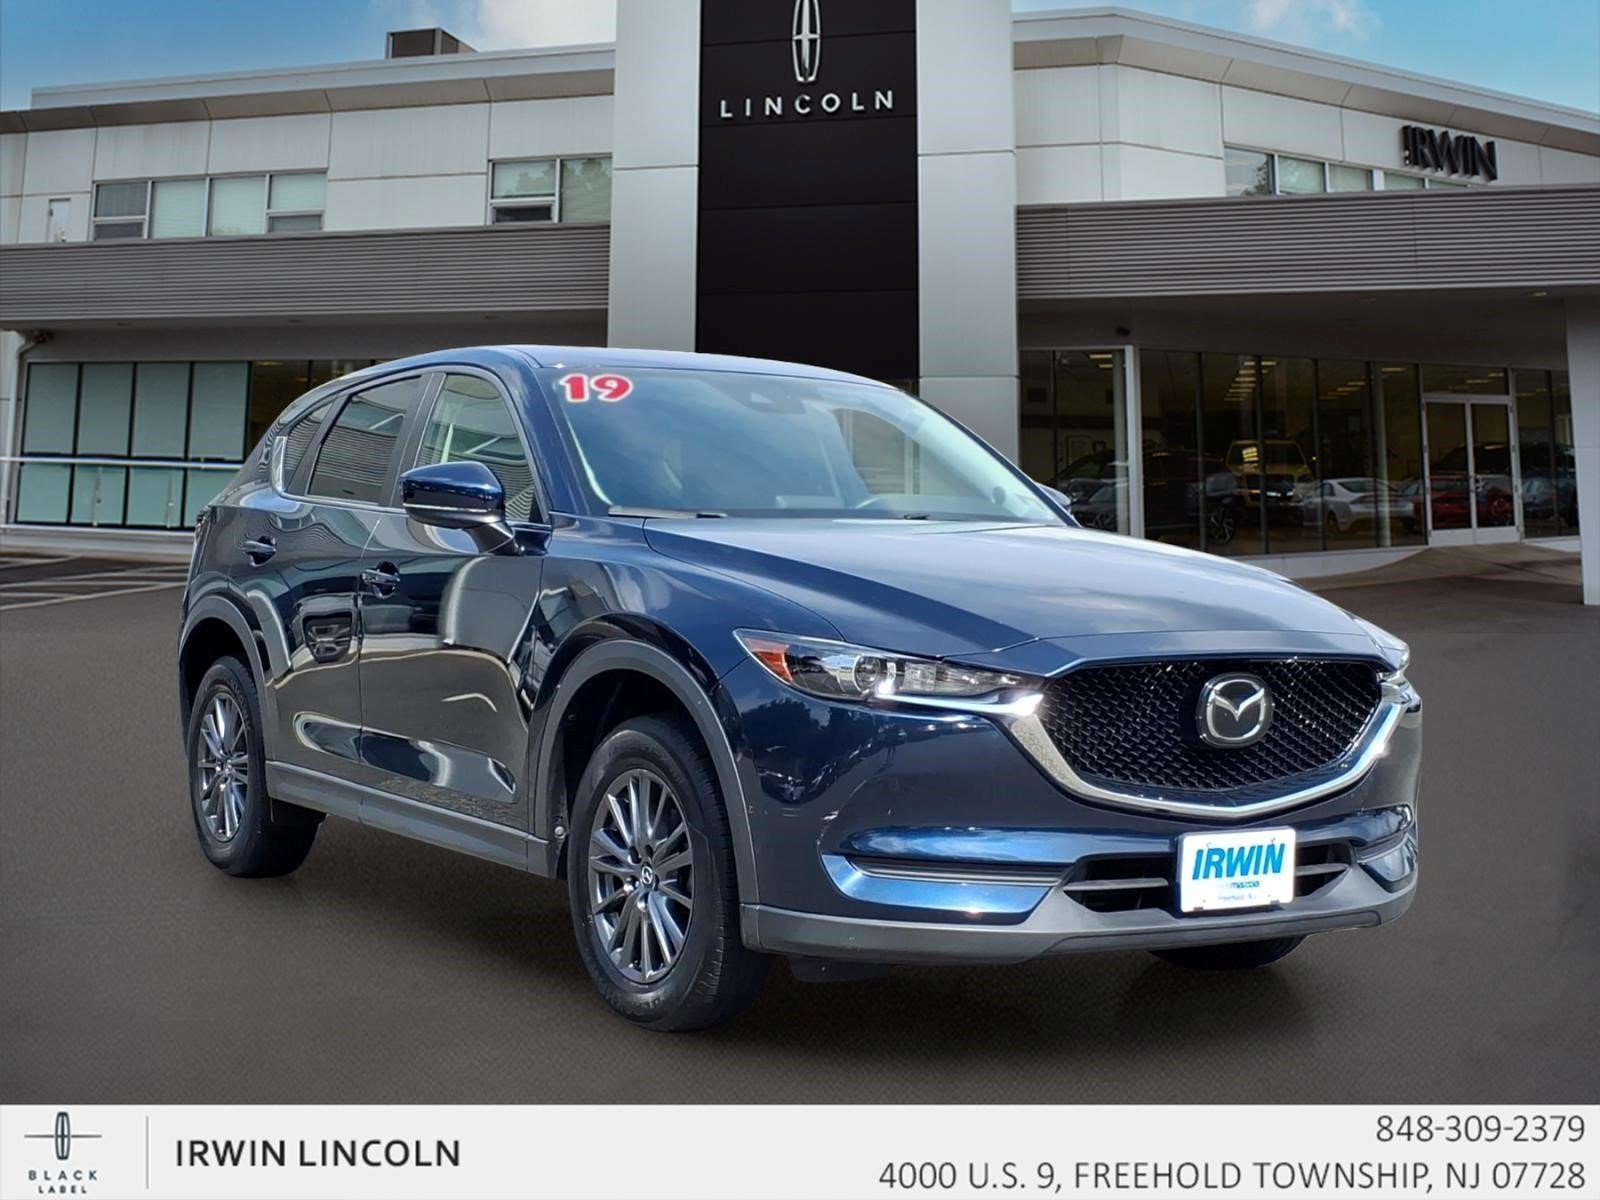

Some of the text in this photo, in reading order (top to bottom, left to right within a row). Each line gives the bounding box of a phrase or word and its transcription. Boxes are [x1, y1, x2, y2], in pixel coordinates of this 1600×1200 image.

[720, 90, 894, 118] LINCOLN
[1401, 125, 1498, 182] IRWIN
[559, 373, 634, 403] 19
[1191, 842, 1286, 880] IRWIN
